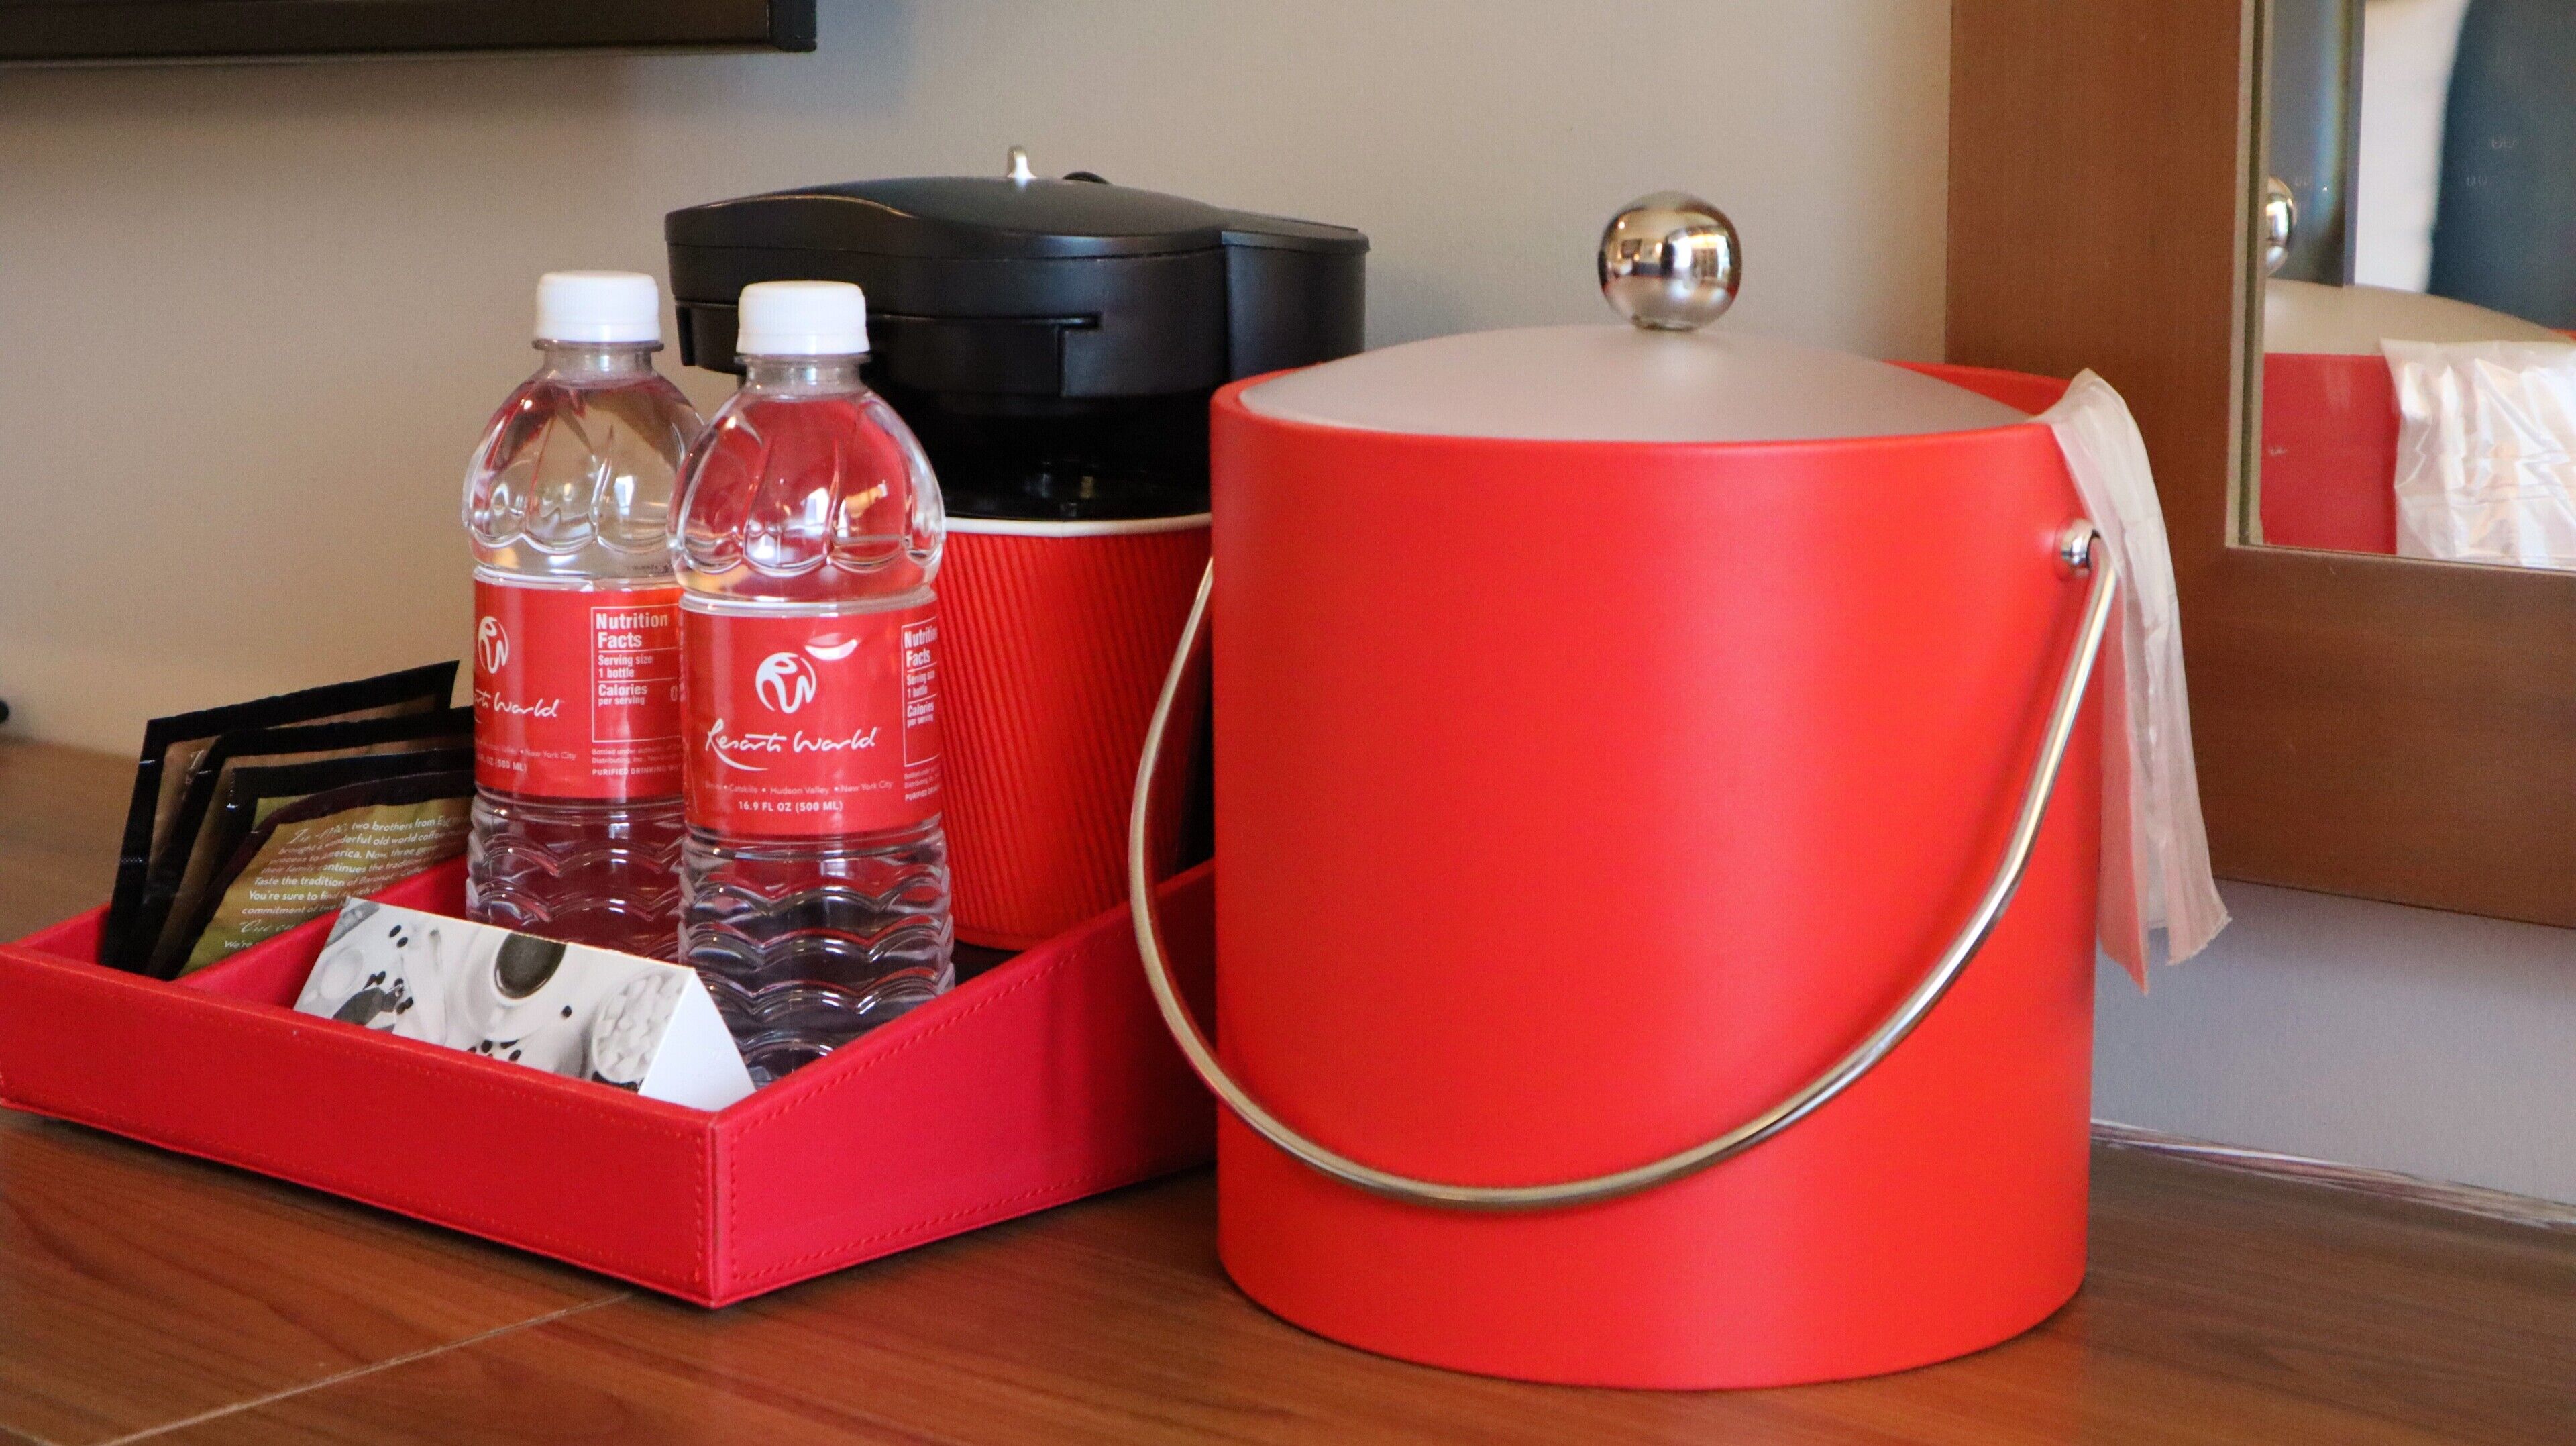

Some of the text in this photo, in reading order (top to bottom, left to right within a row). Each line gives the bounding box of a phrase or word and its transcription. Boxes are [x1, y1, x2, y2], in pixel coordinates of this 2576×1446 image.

[596, 612, 669, 629] Nutrition
[598, 631, 643, 648] Facts
[598, 654, 653, 667] Serving size
[906, 648, 930, 668] Facts
[598, 668, 635, 678] 1 bottle
[907, 673, 926, 686] Serving
[598, 684, 648, 696] Calories
[907, 688, 911, 699] 1
[494, 692, 559, 717] World
[598, 695, 645, 707] per serving
[907, 701, 934, 718] Calories
[705, 718, 876, 771] Resorts World
[542, 750, 559, 759] York
[560, 751, 577, 761] City
[630, 766, 667, 775] DRINKING
[667, 764, 682, 772] WAT
[770, 786, 802, 795] Hudson
[805, 786, 829, 796] Valley
[841, 785, 859, 793] New
[861, 783, 877, 791] York
[879, 780, 892, 790] City
[738, 800, 843, 814] 16.9 FL OZ (500 ML)
[351, 822, 370, 831] two
[371, 821, 413, 832] brothers
[414, 818, 436, 828] from
[373, 835, 390, 845] old
[391, 833, 418, 845] world
[390, 848, 416, 857] three
[317, 862, 366, 874] continues
[368, 863, 384, 872] the
[255, 876, 279, 886] Taste
[281, 875, 298, 886] the
[300, 876, 345, 887] tradition
[347, 876, 358, 886] of
[249, 890, 280, 900] You're
[282, 892, 305, 901] sure
[307, 891, 318, 901] to
[241, 905, 306, 915] commitment
